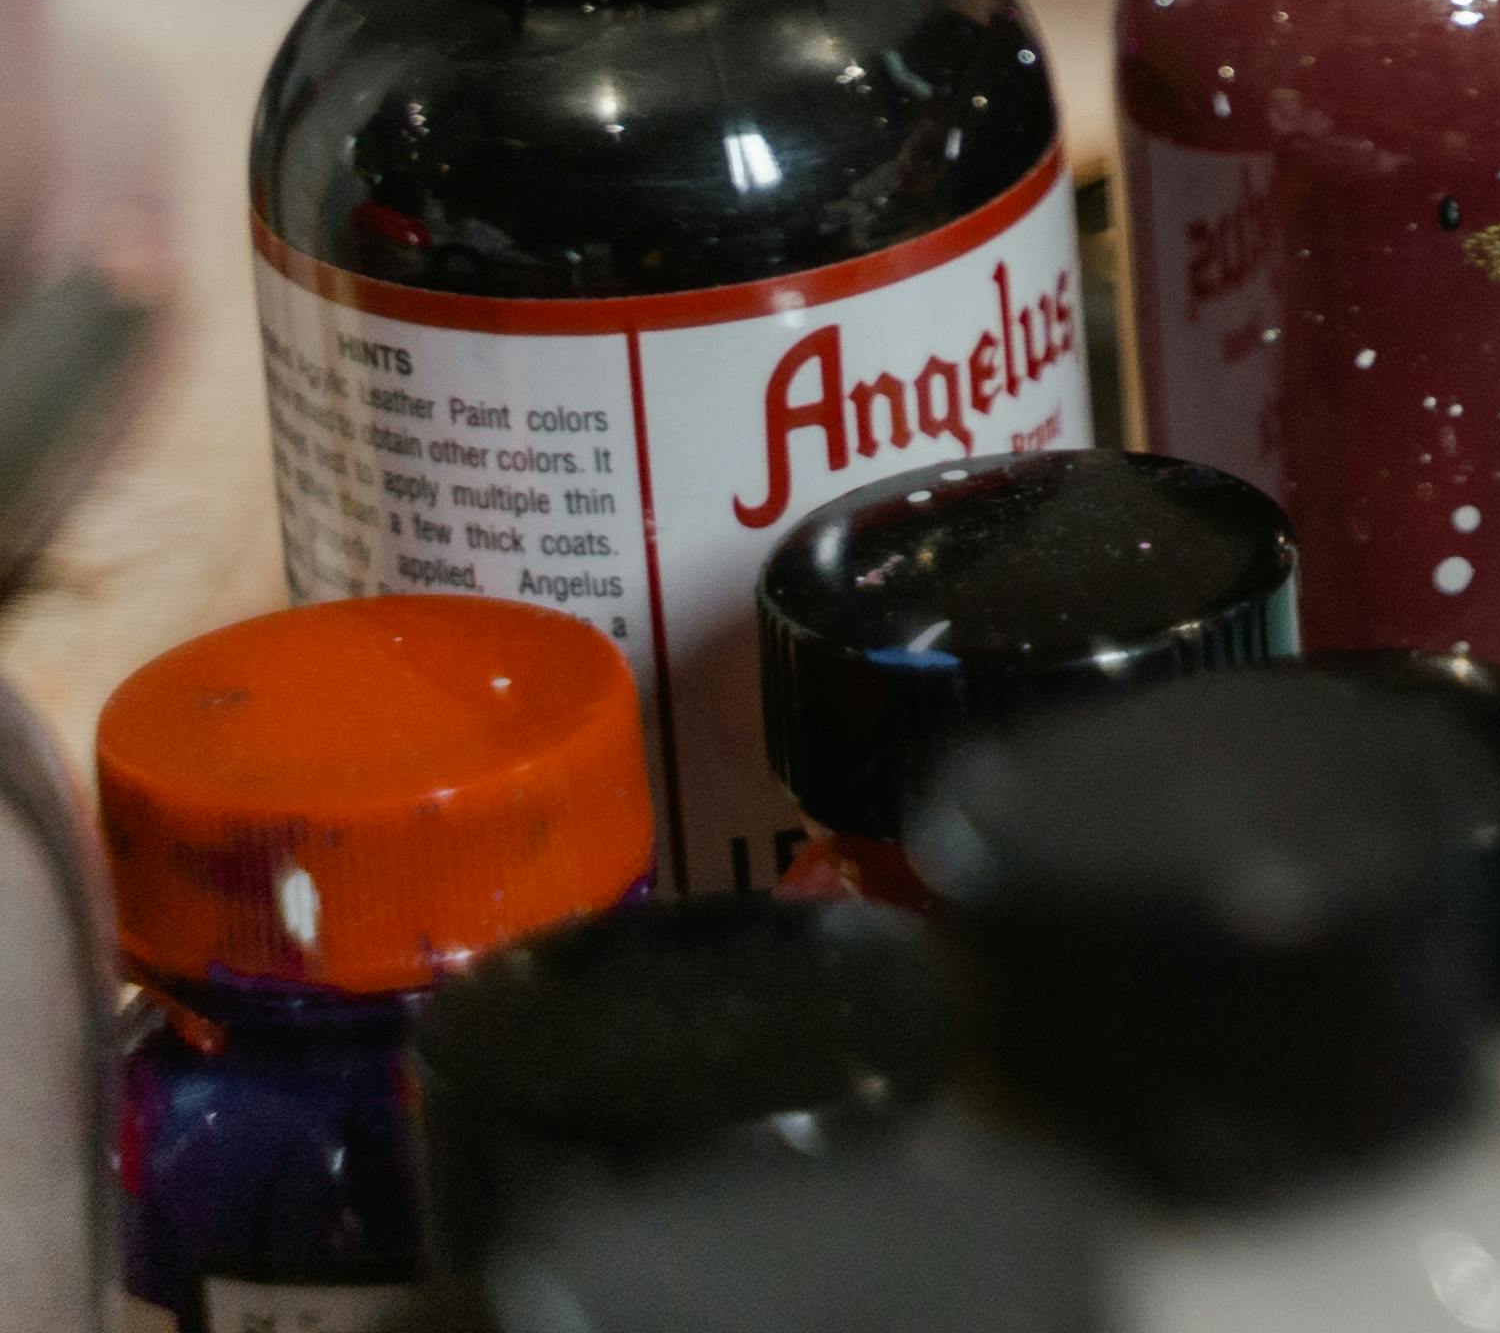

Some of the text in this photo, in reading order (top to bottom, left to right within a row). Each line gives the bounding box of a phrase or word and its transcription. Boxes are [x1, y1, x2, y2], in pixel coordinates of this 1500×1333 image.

[338, 333, 413, 376] HINTS
[732, 259, 1075, 530] Angelus
[448, 397, 512, 430] Paint
[526, 404, 609, 433] colors
[428, 437, 488, 469] other
[495, 447, 587, 474] colors.
[594, 447, 613, 474] It
[450, 483, 552, 518] multiple
[563, 487, 616, 516] thin
[465, 520, 526, 554] thick
[539, 532, 621, 559] coats.
[518, 567, 625, 603] Angelus
